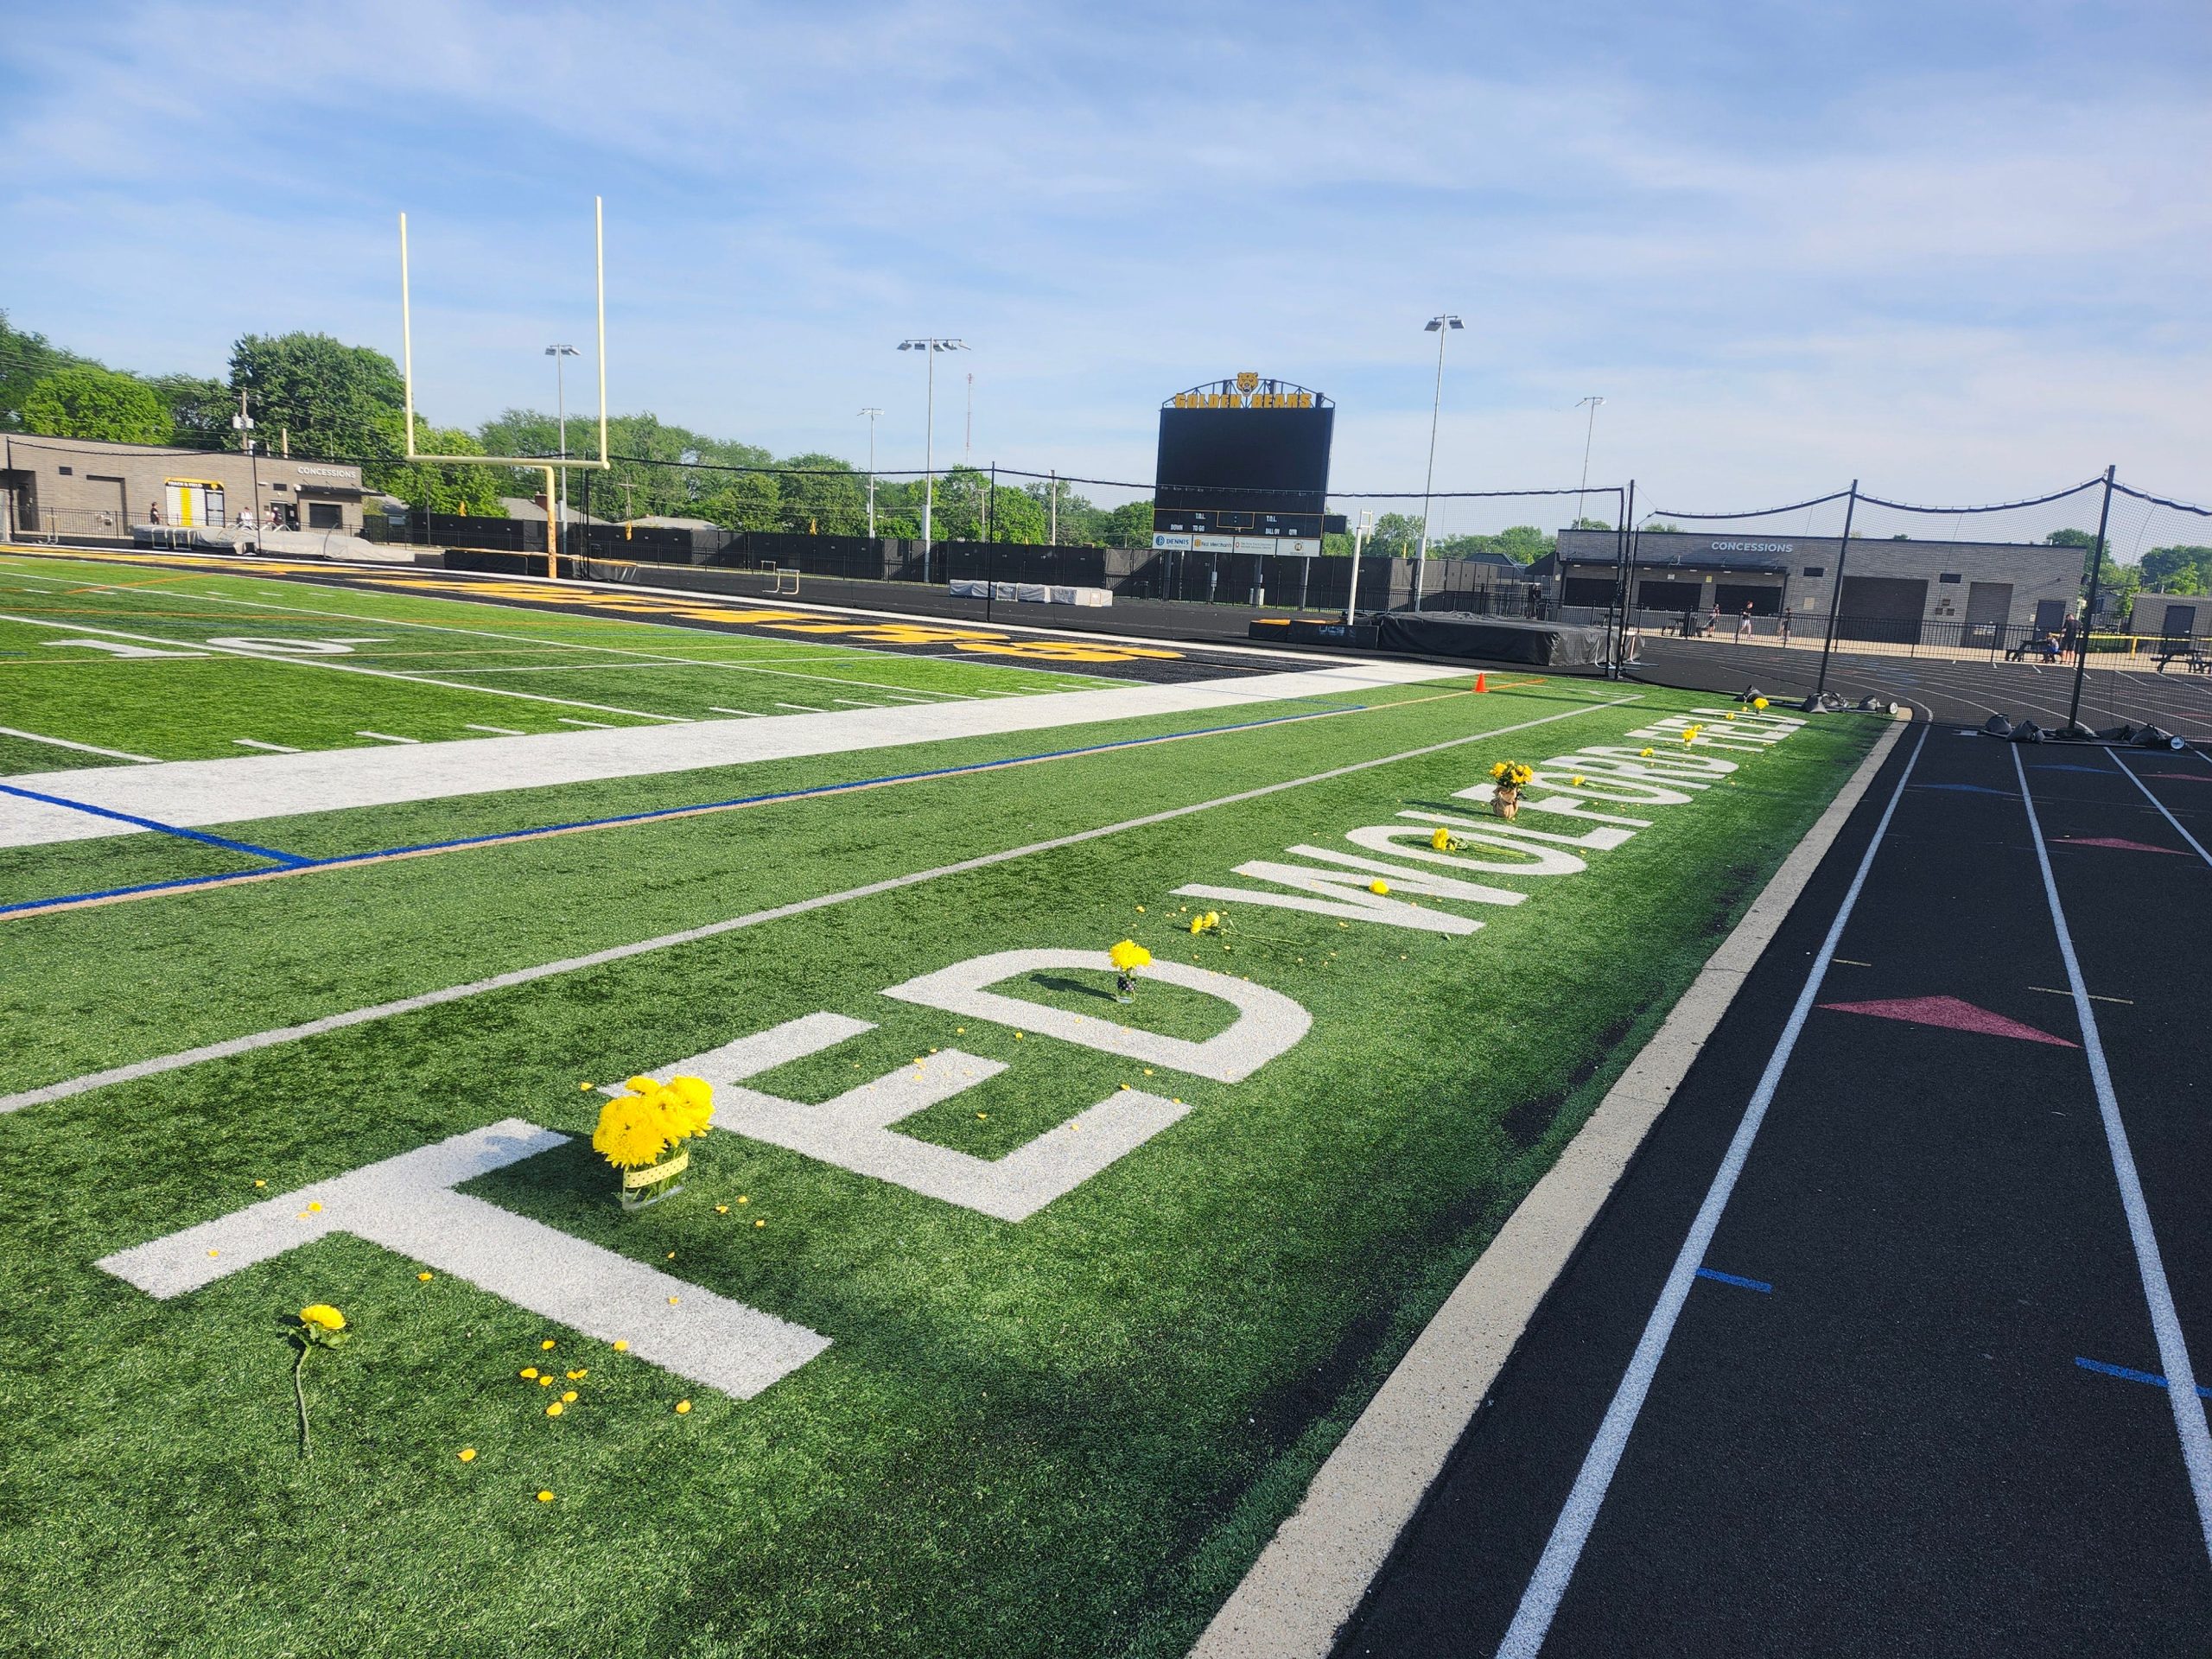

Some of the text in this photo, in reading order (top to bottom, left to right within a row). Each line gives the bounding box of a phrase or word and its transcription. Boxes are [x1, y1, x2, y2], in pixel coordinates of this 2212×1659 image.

[1175, 394, 1312, 408] GOLDEN BEARS
[297, 467, 356, 479] CONCESSIONS
[1712, 542, 1793, 553] CONCESSIONS
[38, 637, 356, 658] 10
[94, 708, 1808, 1401] TED WOLFORD FIELD
